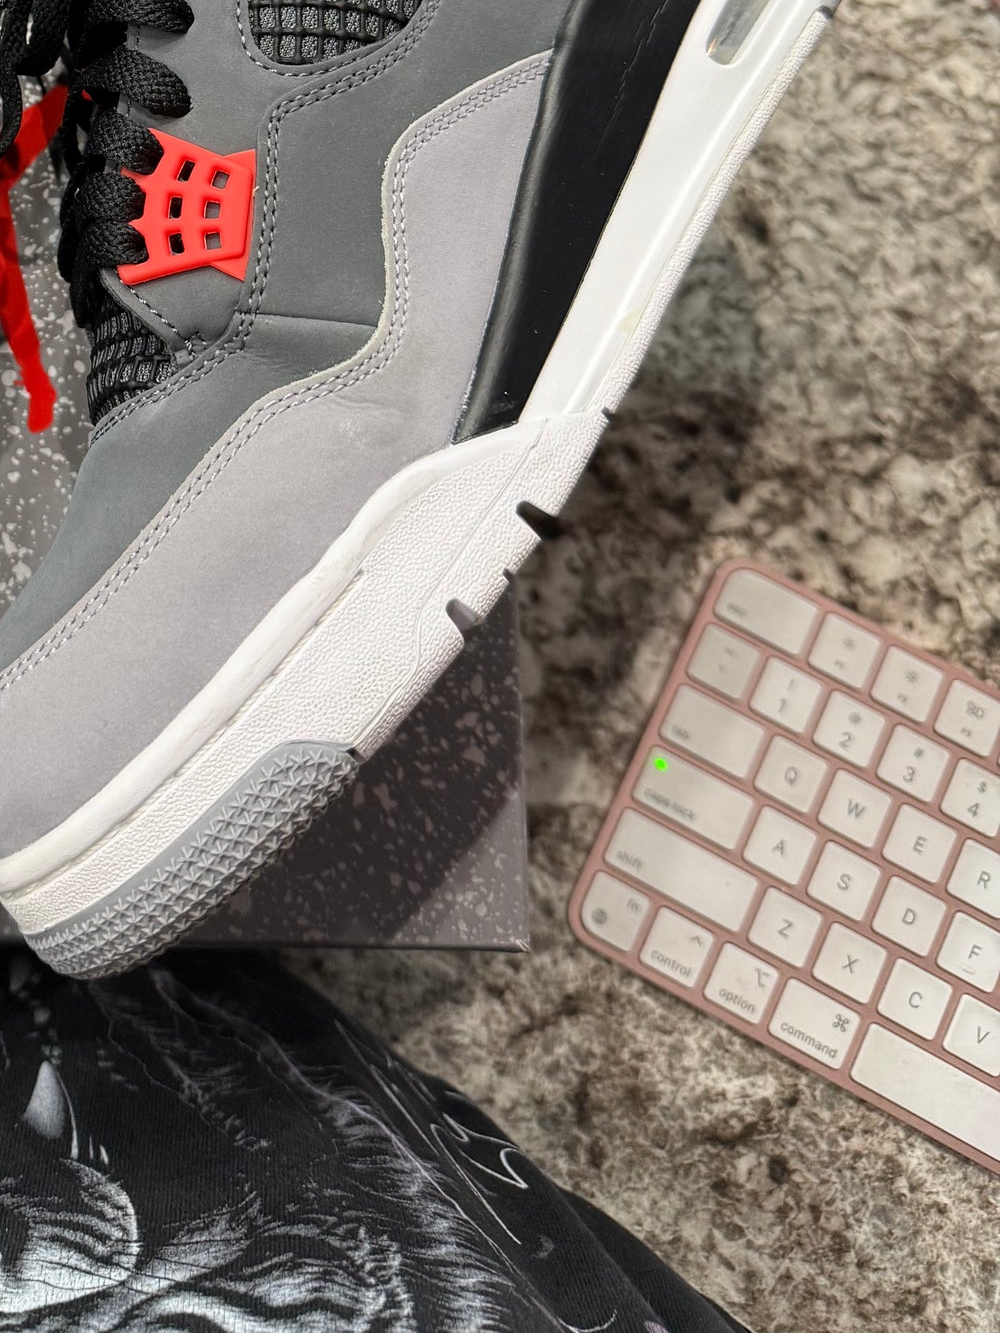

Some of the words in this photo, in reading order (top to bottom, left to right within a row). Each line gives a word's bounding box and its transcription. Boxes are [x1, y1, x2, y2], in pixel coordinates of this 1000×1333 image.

[838, 731, 852, 749] 2
[783, 766, 799, 786] Q
[902, 766, 916, 783] 3
[846, 798, 866, 819] W
[967, 802, 980, 817] 4
[771, 839, 786, 857] A
[912, 835, 928, 856] E
[616, 849, 644, 870] shift
[836, 873, 851, 891] S
[976, 870, 992, 889] R
[901, 907, 916, 926] D
[777, 918, 794, 939] Z
[967, 944, 983, 960] F
[650, 949, 693, 978] control
[841, 954, 859, 975] X
[718, 987, 756, 1014] option
[908, 991, 923, 1009] C
[780, 1021, 839, 1059] command
[976, 1026, 990, 1044] V
